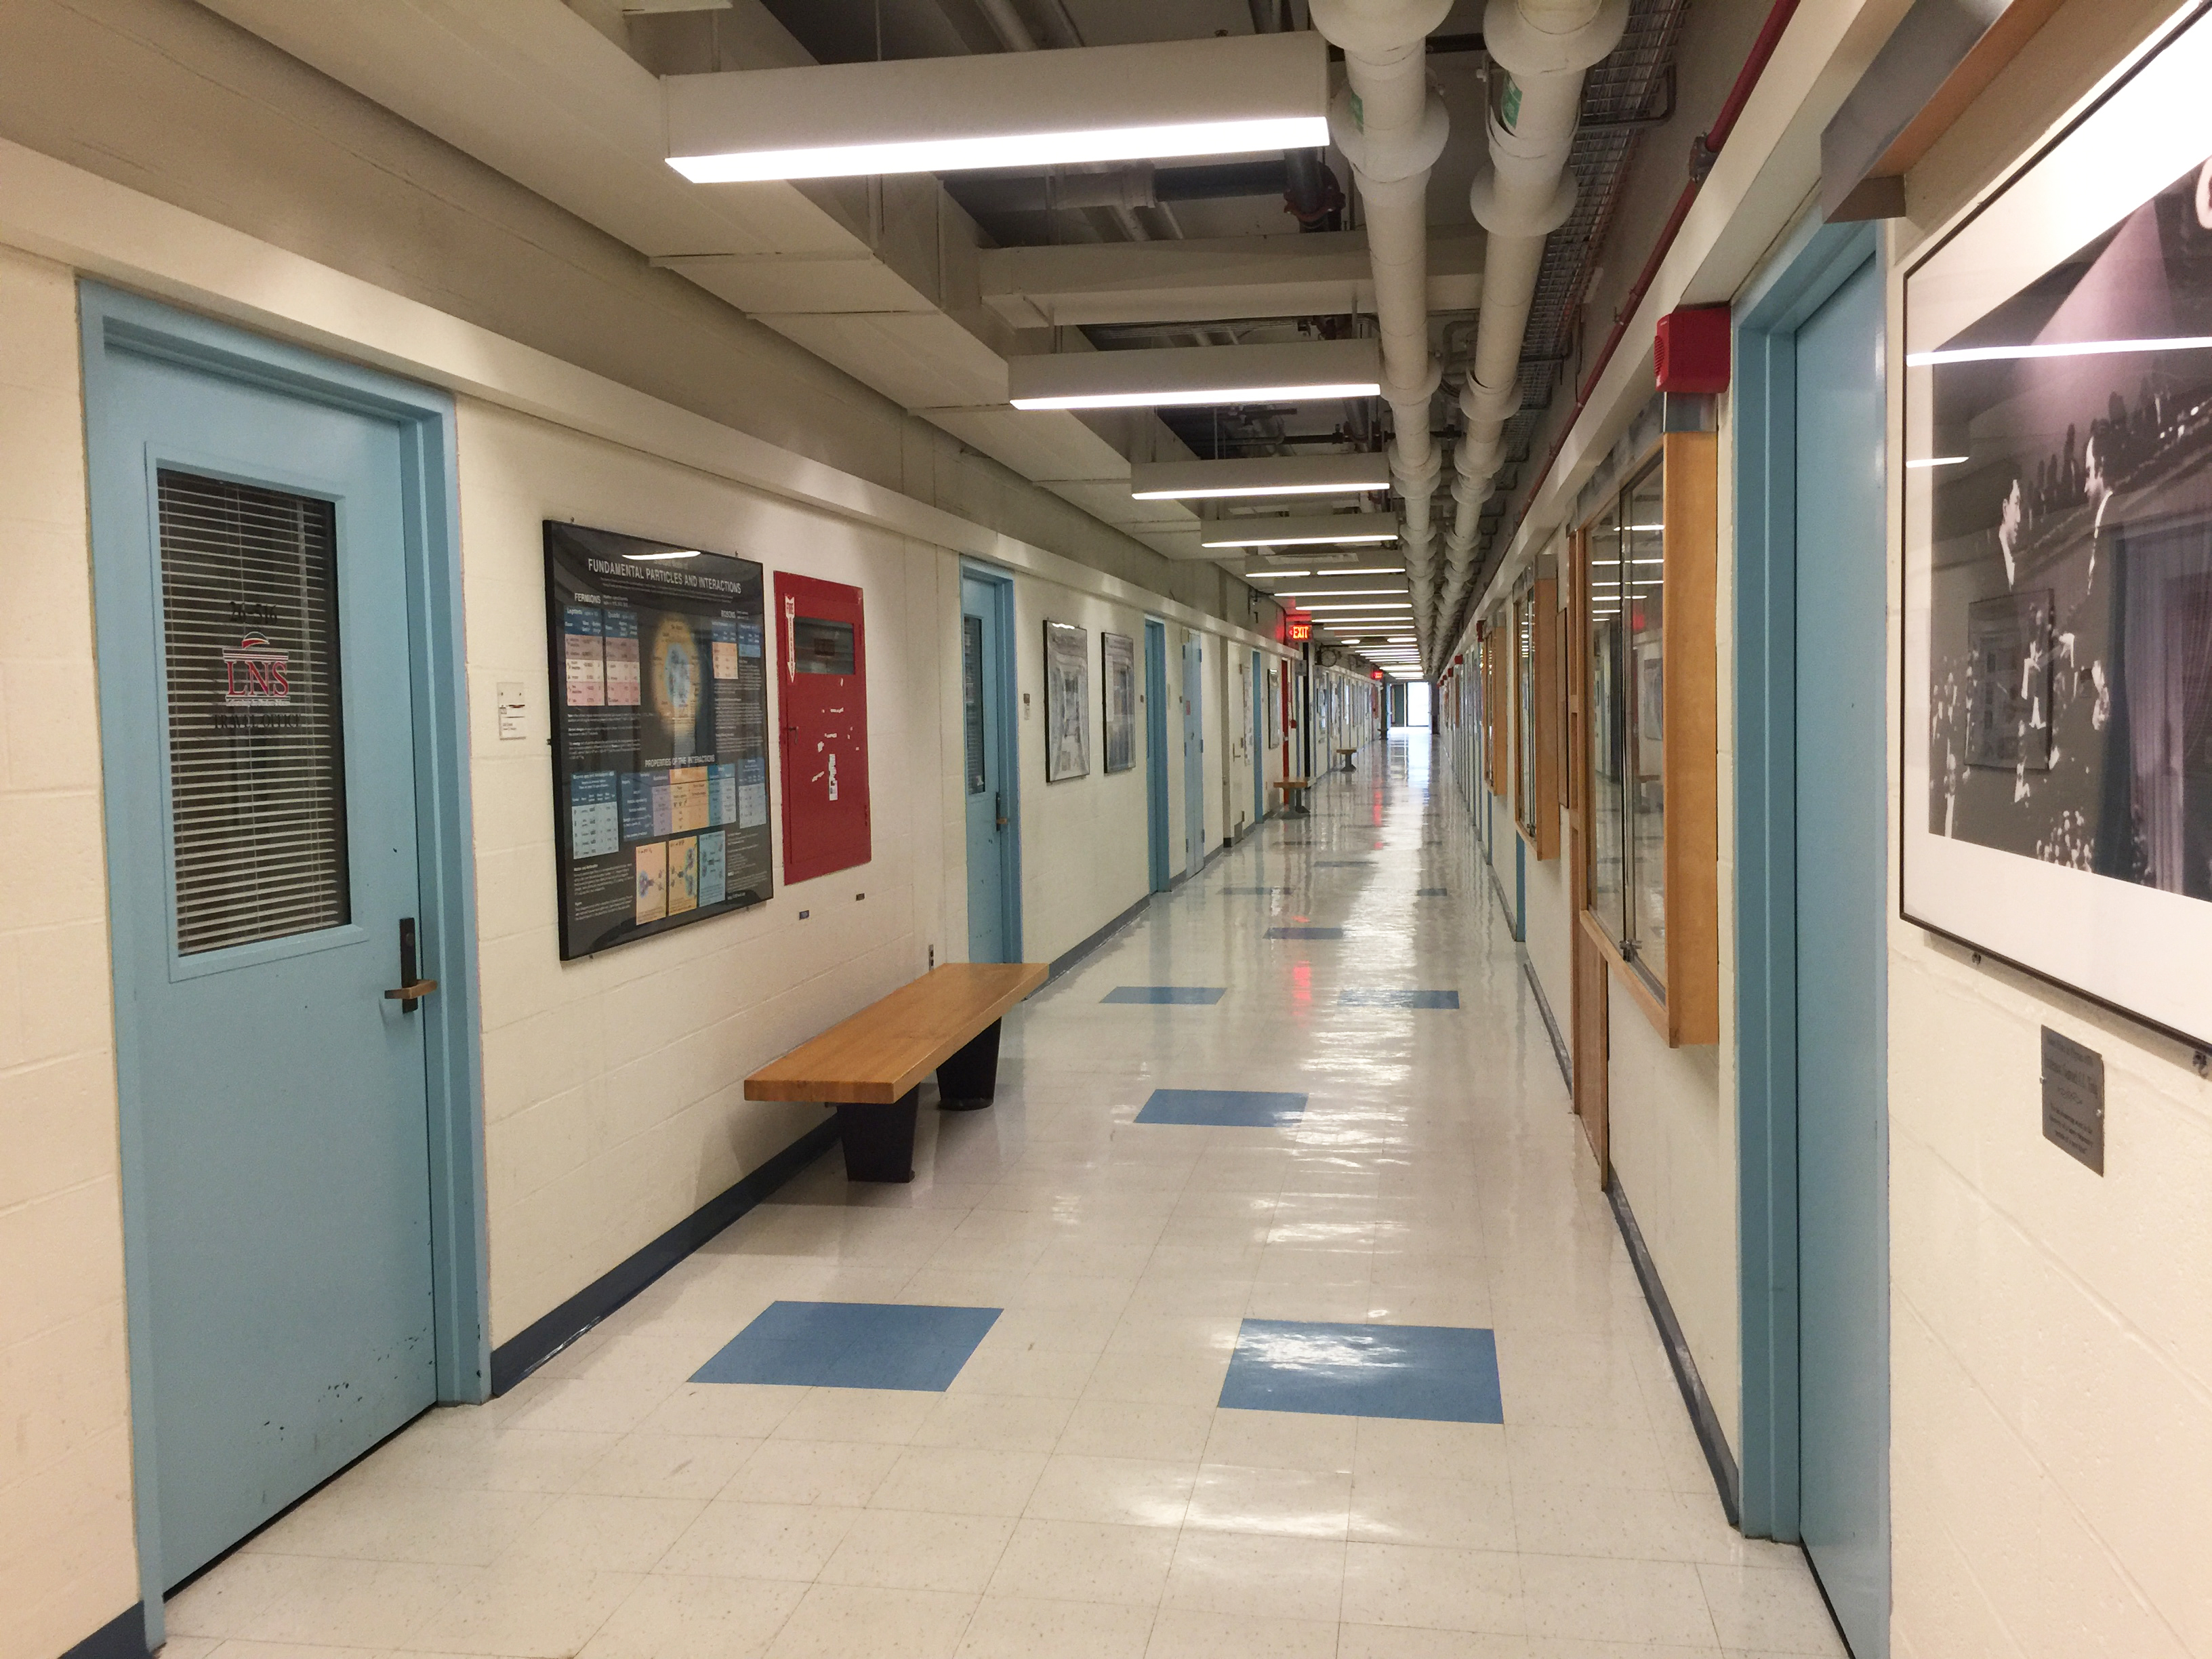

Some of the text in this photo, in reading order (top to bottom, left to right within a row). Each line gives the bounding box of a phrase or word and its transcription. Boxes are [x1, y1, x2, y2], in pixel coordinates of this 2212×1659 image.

[588, 558, 644, 579] FUNDAMENTAL
[646, 568, 683, 585] PARTICLES
[684, 575, 697, 588] AND
[699, 577, 742, 594] INTERACTIONS
[574, 592, 601, 605] FERMIONS
[1292, 626, 1309, 639] EXIT
[224, 659, 289, 697] LNS
